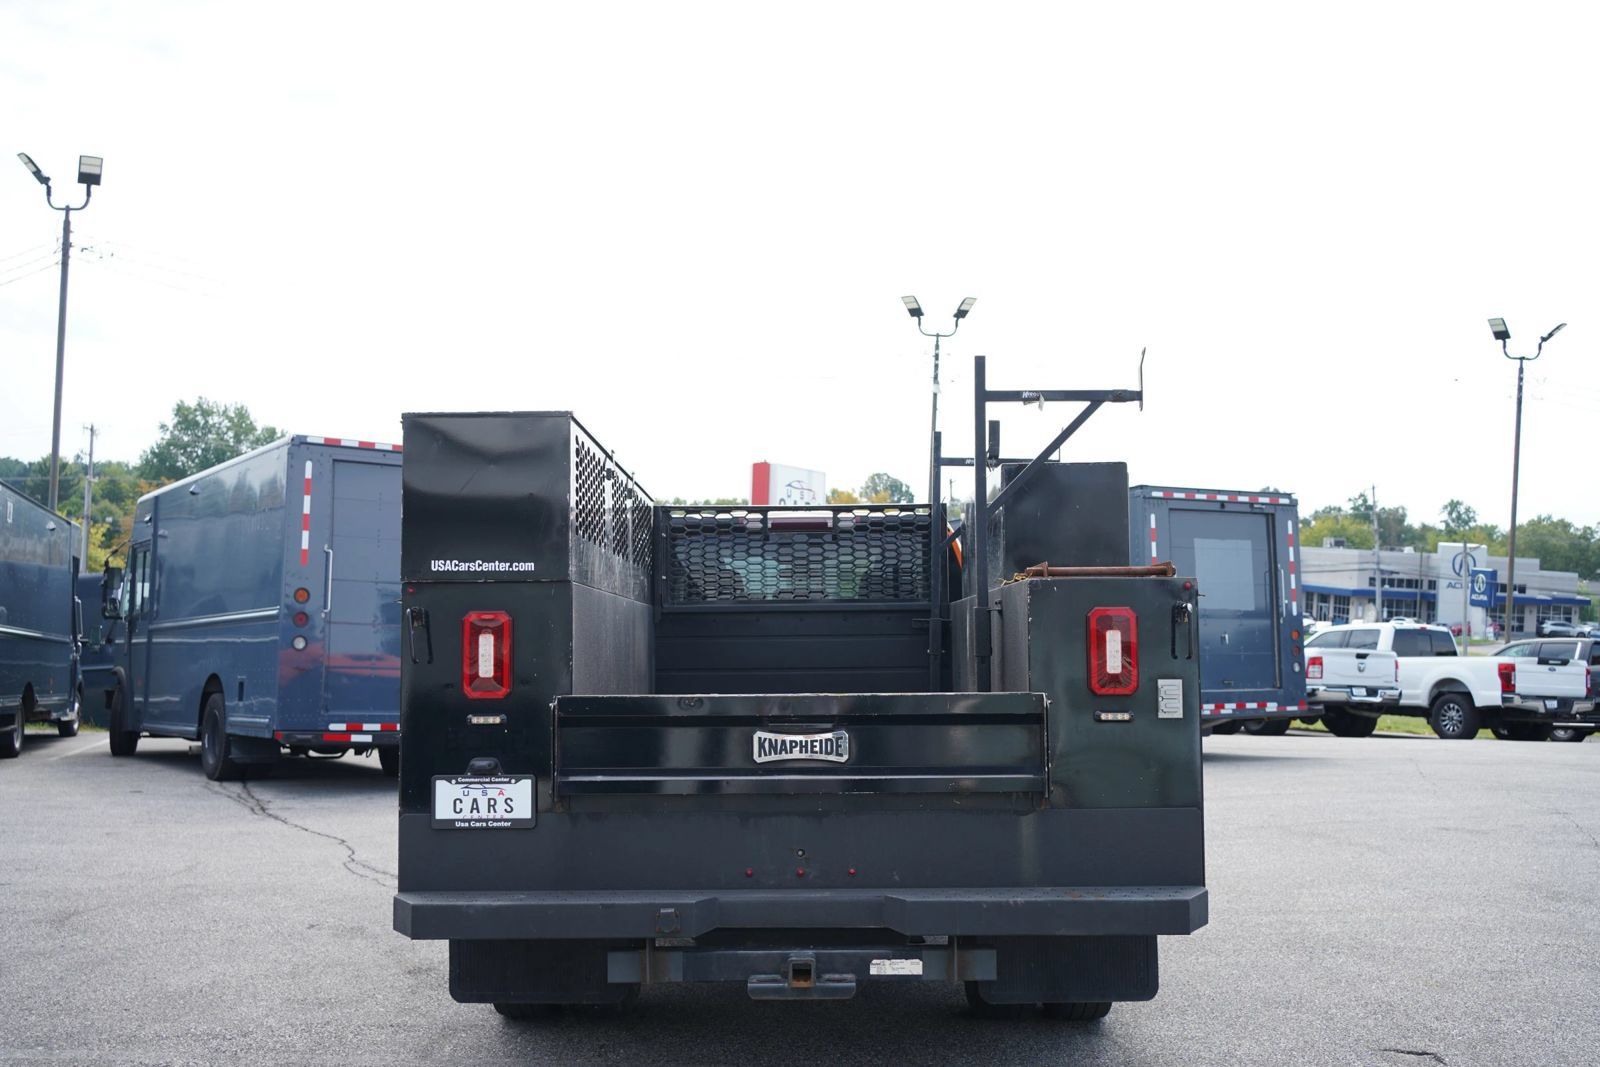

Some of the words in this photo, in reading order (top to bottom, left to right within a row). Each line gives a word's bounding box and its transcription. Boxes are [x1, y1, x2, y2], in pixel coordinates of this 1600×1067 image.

[430, 559, 535, 572] USACarsCenter.com
[757, 736, 844, 758] KNAPHEIDE
[453, 798, 514, 814] CARS
